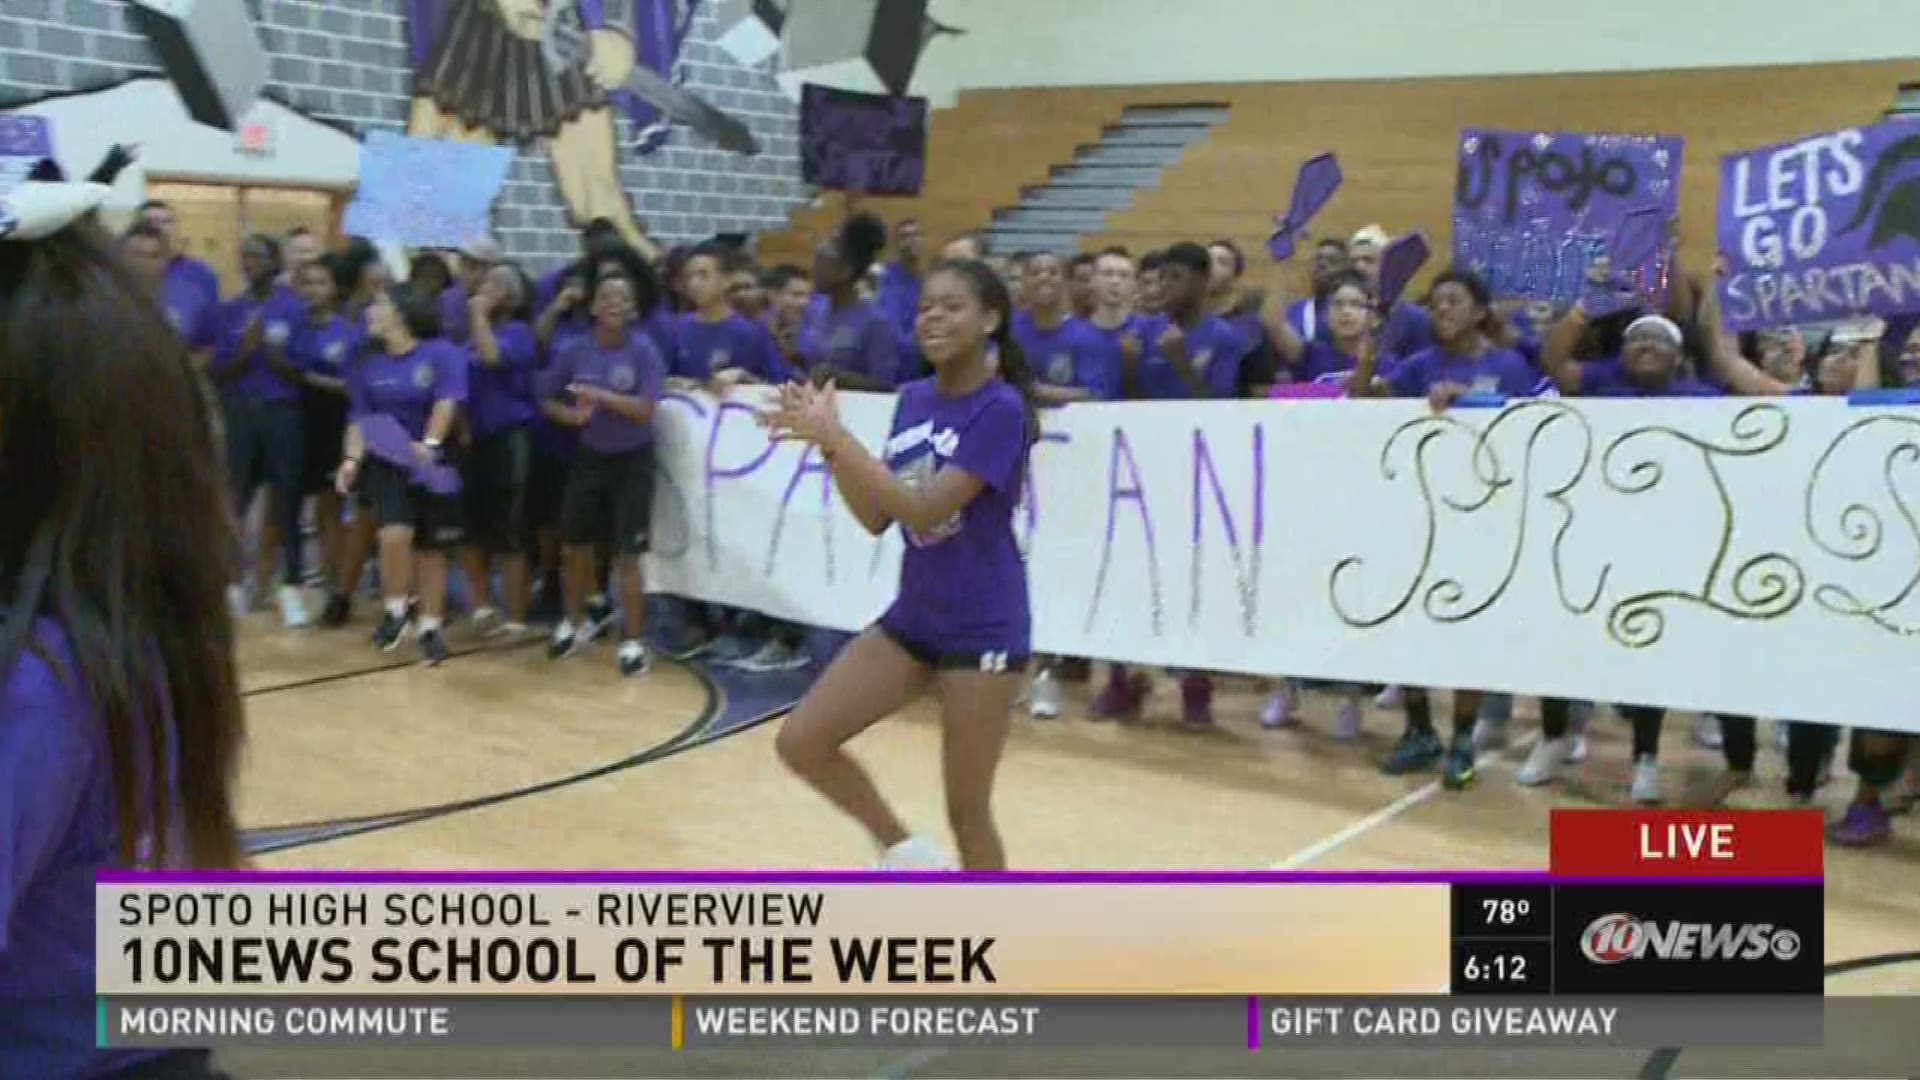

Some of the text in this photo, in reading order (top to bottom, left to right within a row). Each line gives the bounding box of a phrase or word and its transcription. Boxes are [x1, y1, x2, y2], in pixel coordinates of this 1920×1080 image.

[1734, 129, 1864, 217] LETS
[1742, 204, 1827, 267] GO
[655, 394, 1263, 637] SPAAN
